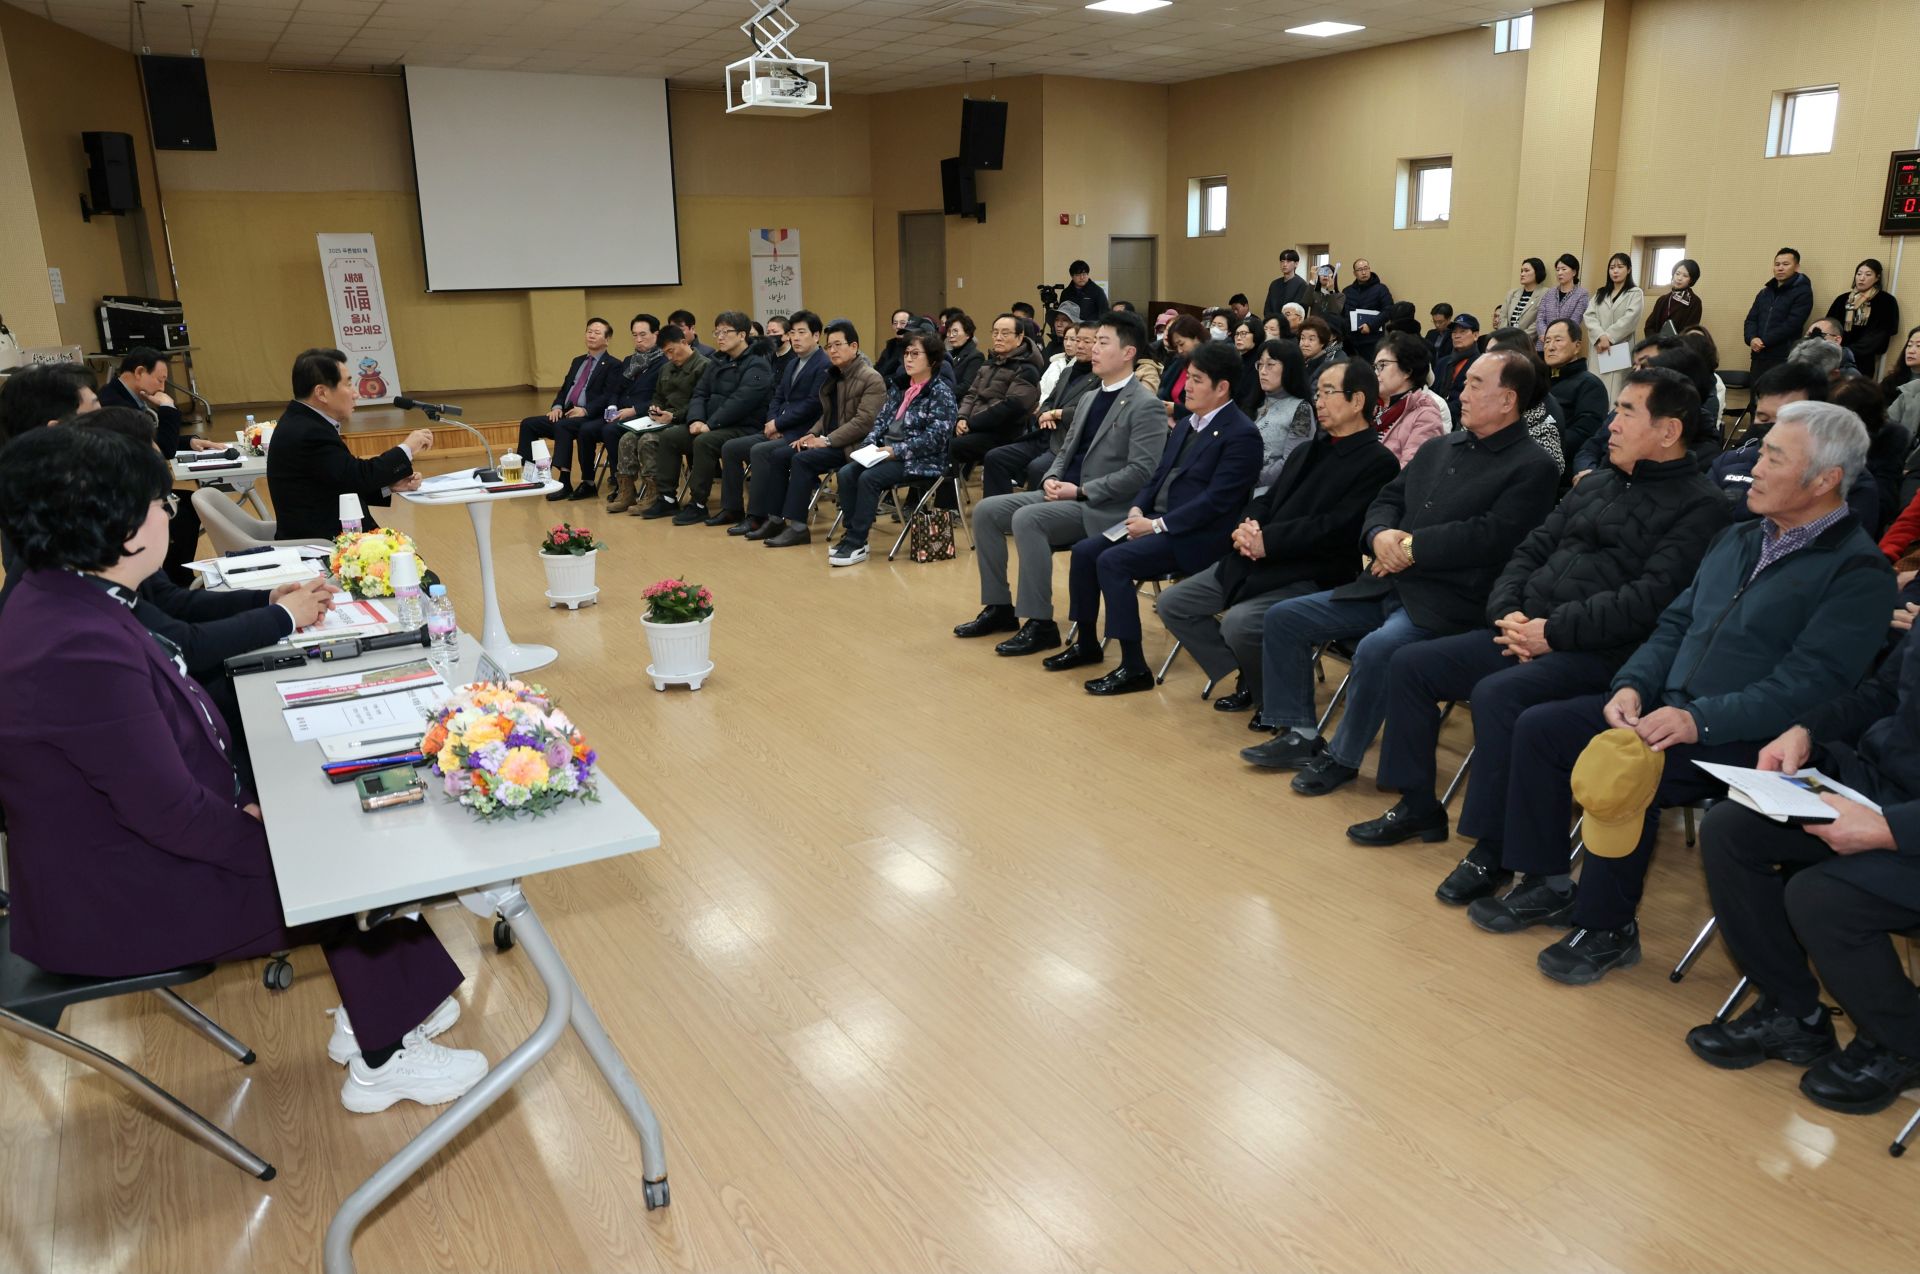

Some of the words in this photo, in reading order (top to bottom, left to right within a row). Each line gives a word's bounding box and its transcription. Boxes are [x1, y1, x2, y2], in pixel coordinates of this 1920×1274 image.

[344, 273, 363, 283] 새해
[343, 286, 371, 311] 福
[351, 314, 370, 324] 을사
[343, 325, 382, 336] 안으세요
